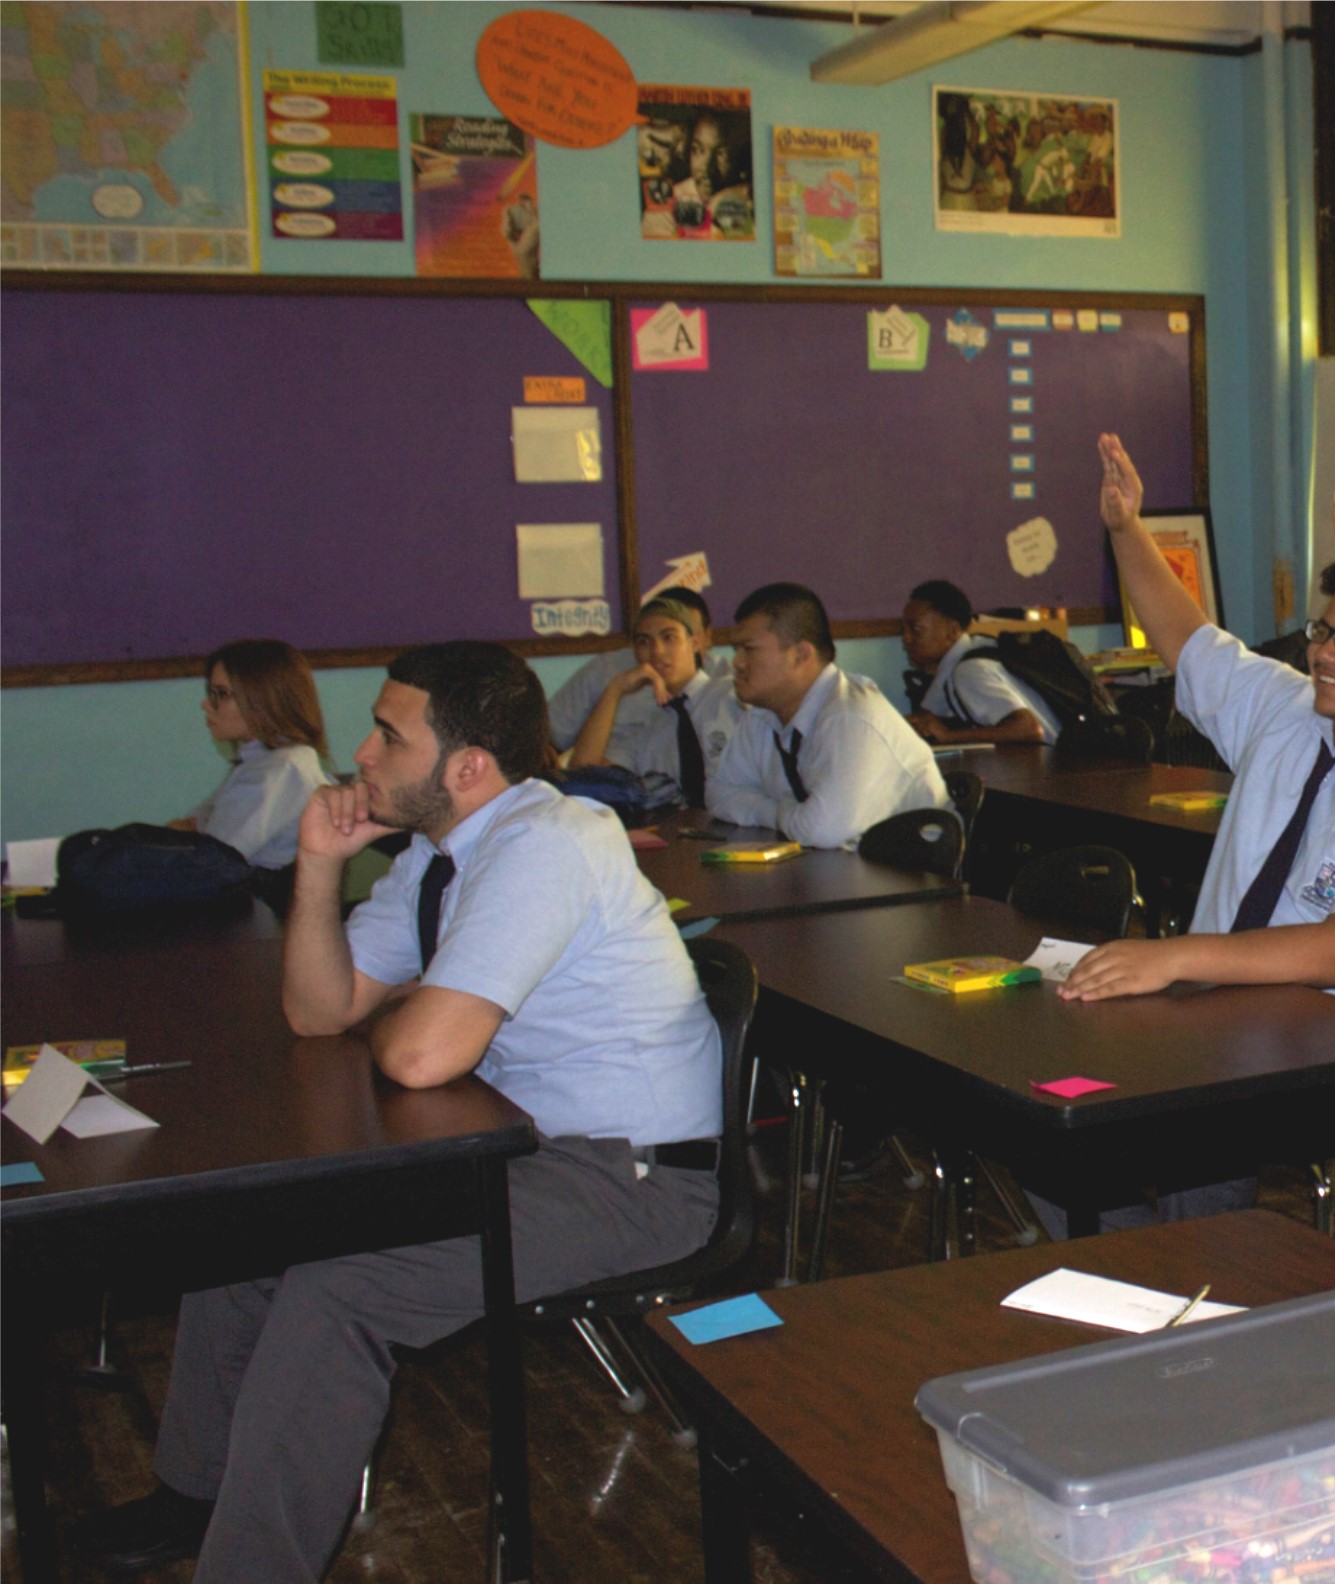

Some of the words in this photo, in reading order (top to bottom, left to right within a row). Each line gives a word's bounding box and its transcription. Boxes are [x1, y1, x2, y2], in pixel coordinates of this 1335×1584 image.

[268, 71, 289, 82] The
[292, 75, 338, 87] Writing
[340, 75, 391, 89] Process
[453, 117, 509, 137] Reading
[672, 322, 695, 352] A
[878, 327, 893, 348] B
[532, 605, 609, 630] Integrity
